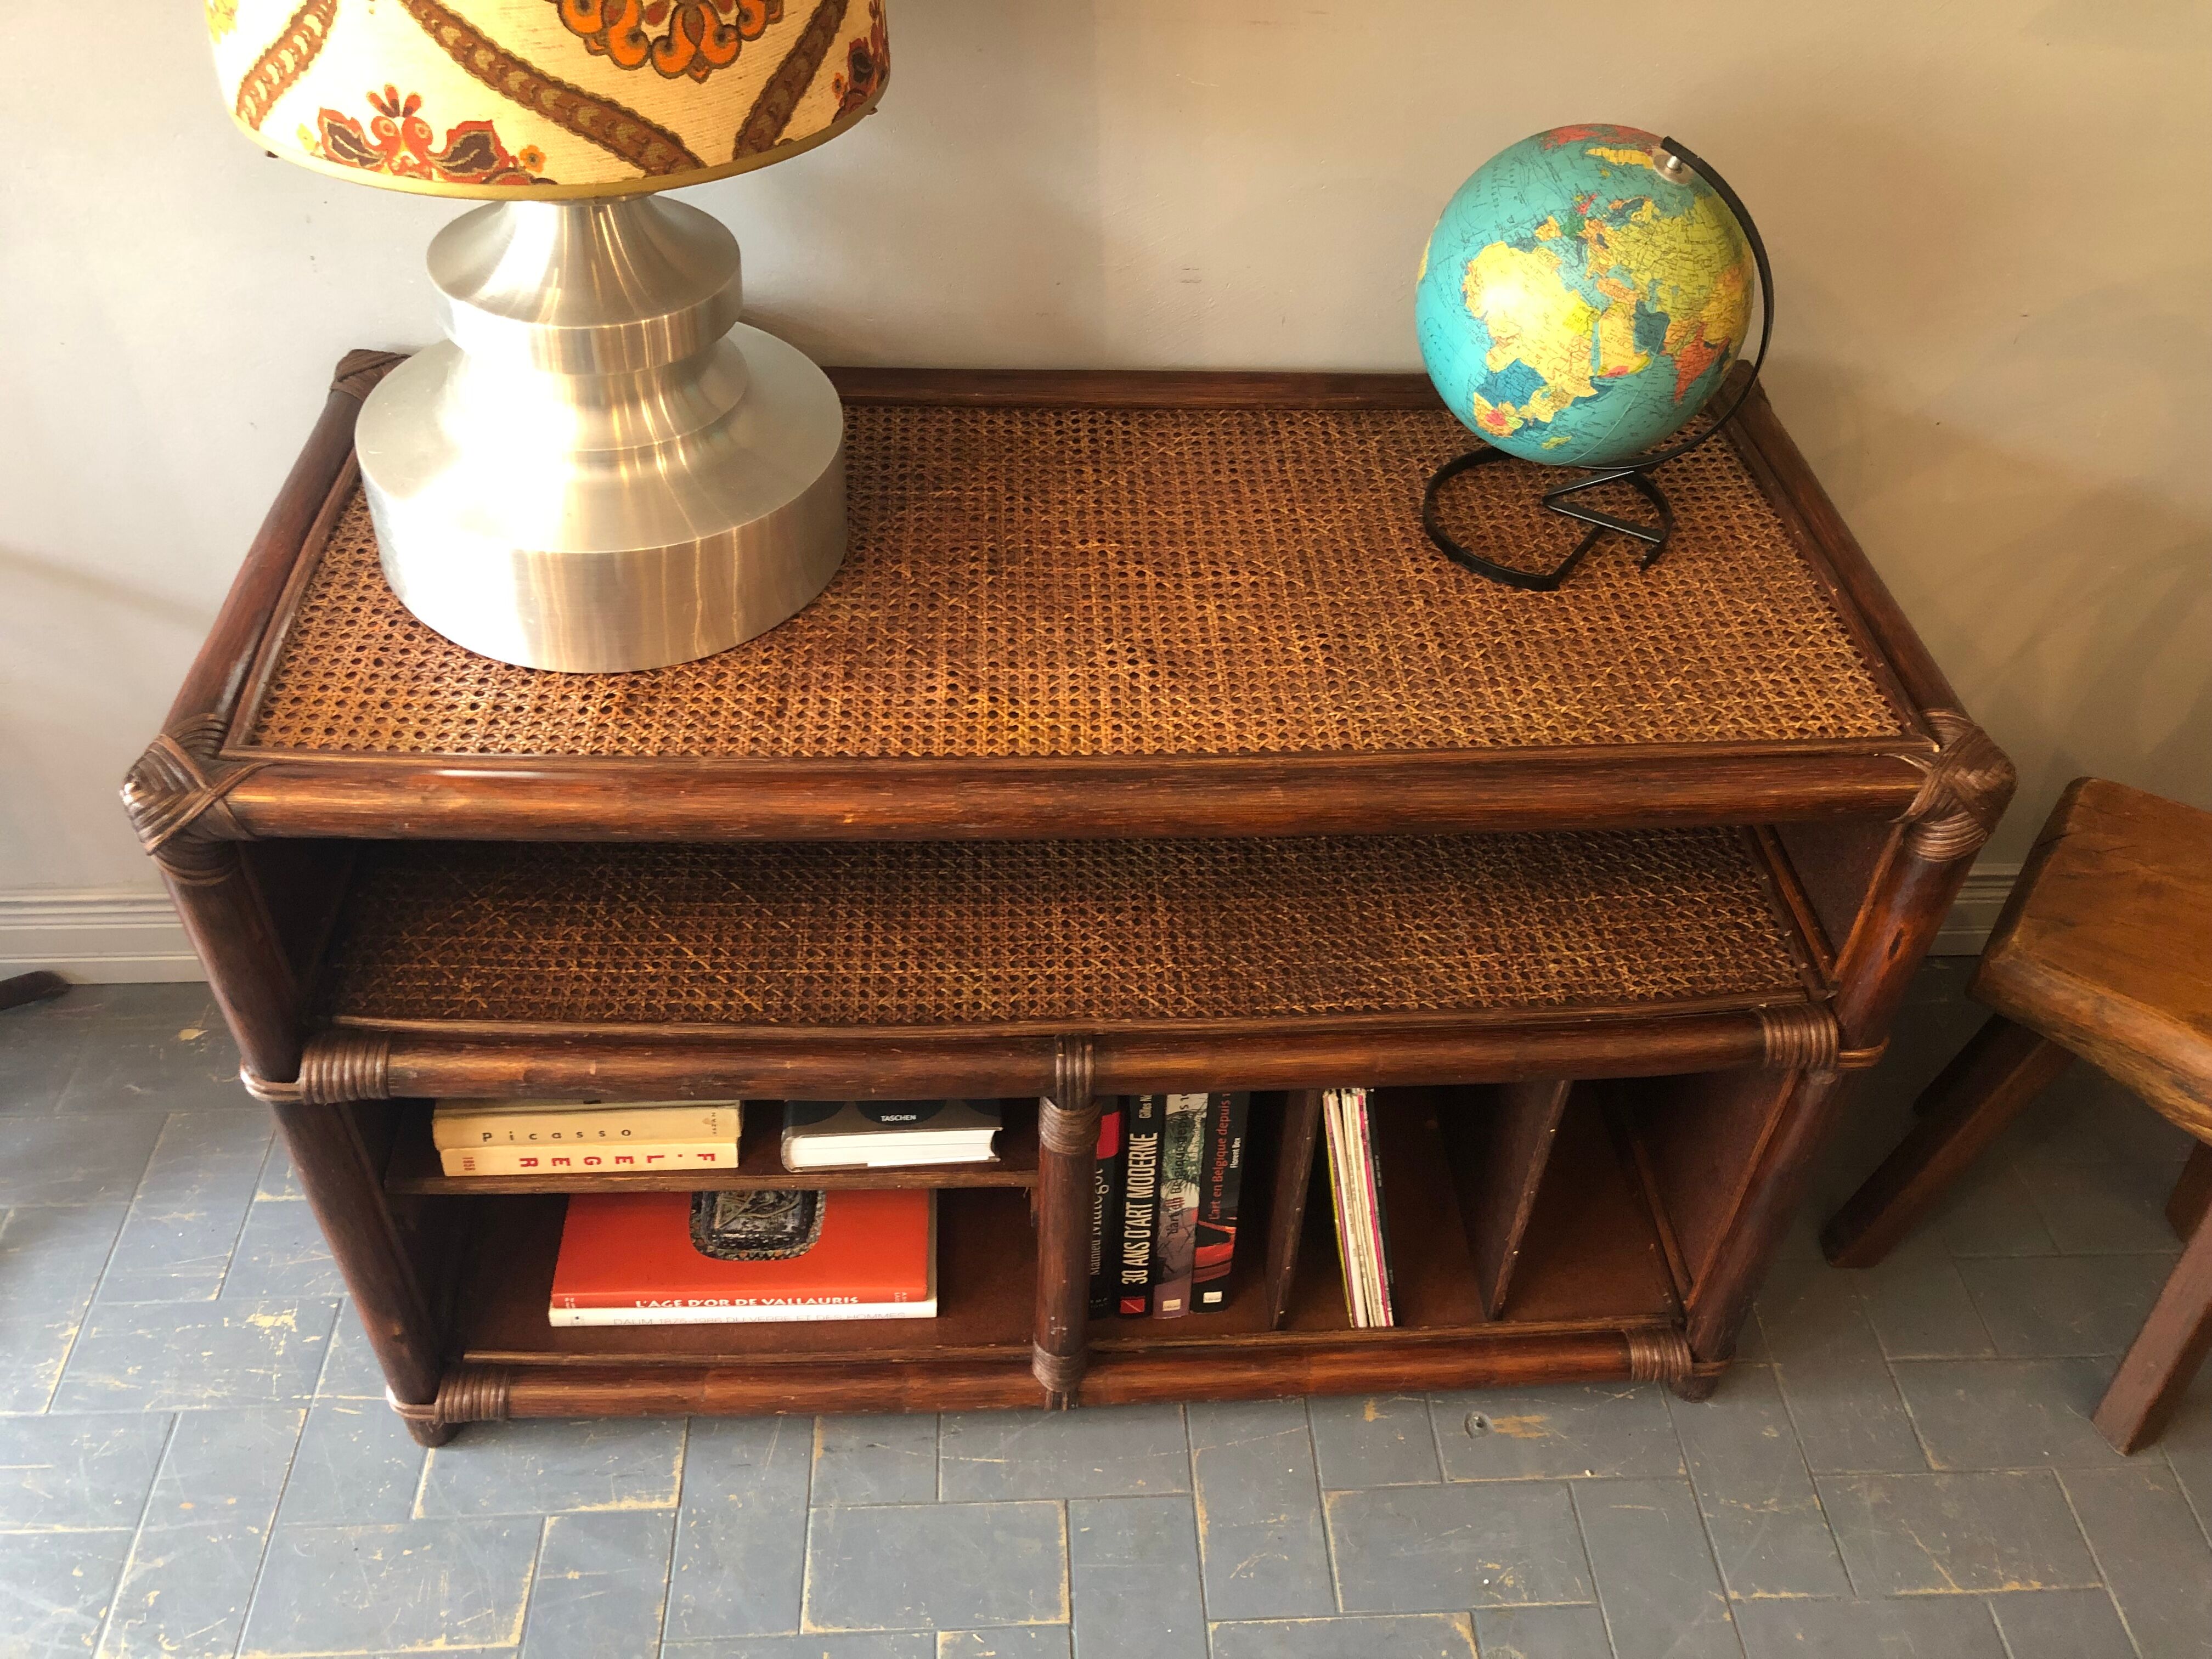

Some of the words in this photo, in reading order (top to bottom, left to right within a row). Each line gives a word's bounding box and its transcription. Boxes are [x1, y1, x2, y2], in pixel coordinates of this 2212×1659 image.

[1138, 1102, 1152, 1119] Gilles
[1216, 1099, 1232, 1135] depuis
[1232, 1137, 1242, 1148] Bex
[1126, 1132, 1159, 1198] MODERNE
[1212, 1138, 1228, 1182] Belgique
[1229, 1149, 1240, 1169] Florent
[1213, 1184, 1223, 1197] en
[1124, 1201, 1153, 1238] D'ART
[1122, 1242, 1151, 1266] ANS
[1121, 1269, 1149, 1284] 30
[635, 1299, 683, 1308] L'AGE
[687, 1298, 730, 1307] D'OR
[735, 1298, 758, 1306] DE
[761, 1296, 860, 1305] VALLAURIS
